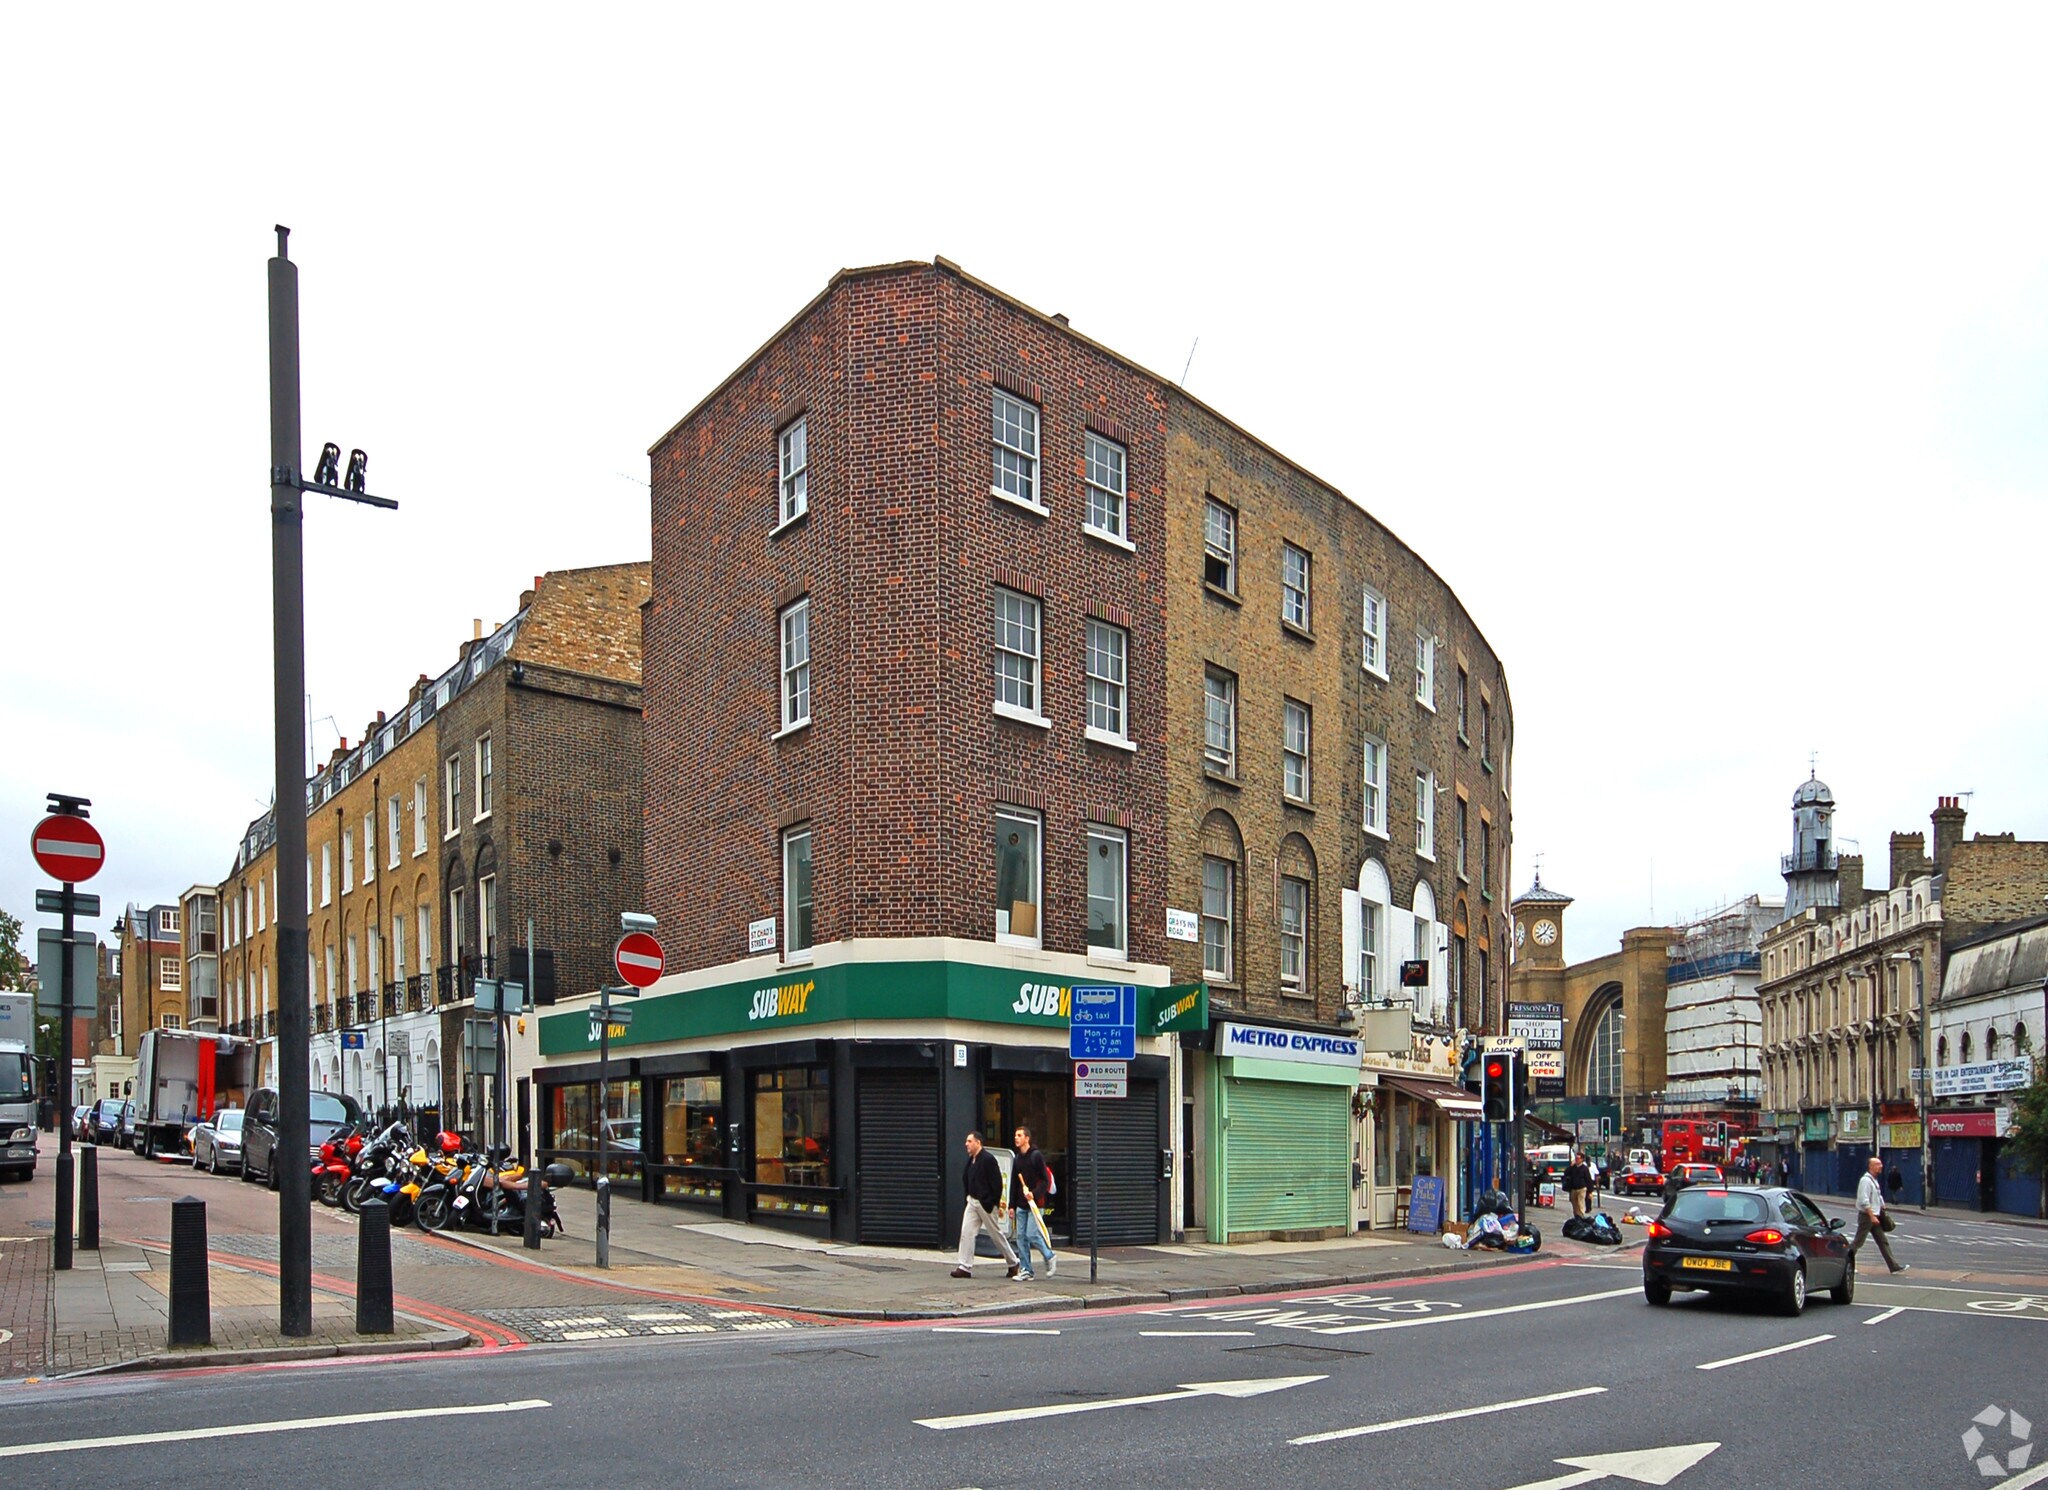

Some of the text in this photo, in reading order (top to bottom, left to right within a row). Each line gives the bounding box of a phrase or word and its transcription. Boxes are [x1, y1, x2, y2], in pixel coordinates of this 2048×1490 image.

[1169, 927, 1183, 936] ROAD
[751, 938, 766, 948] STREET
[749, 980, 814, 1020] SUBWAY
[1158, 990, 1199, 1026] SUBWAY
[1512, 1028, 1558, 1038] TO LET
[1231, 1027, 1357, 1055] METRO EXPRESS
[1543, 1041, 1560, 1049] 7100
[1944, 1069, 1948, 1078] IN
[1950, 1068, 1959, 1078] CAR
[1960, 1065, 1996, 1076] ENTERTAINMENT
[1932, 1119, 1964, 1131] Pioneer
[1281, 1294, 1462, 1312] BUS
[1136, 1306, 1391, 1330] LANE
